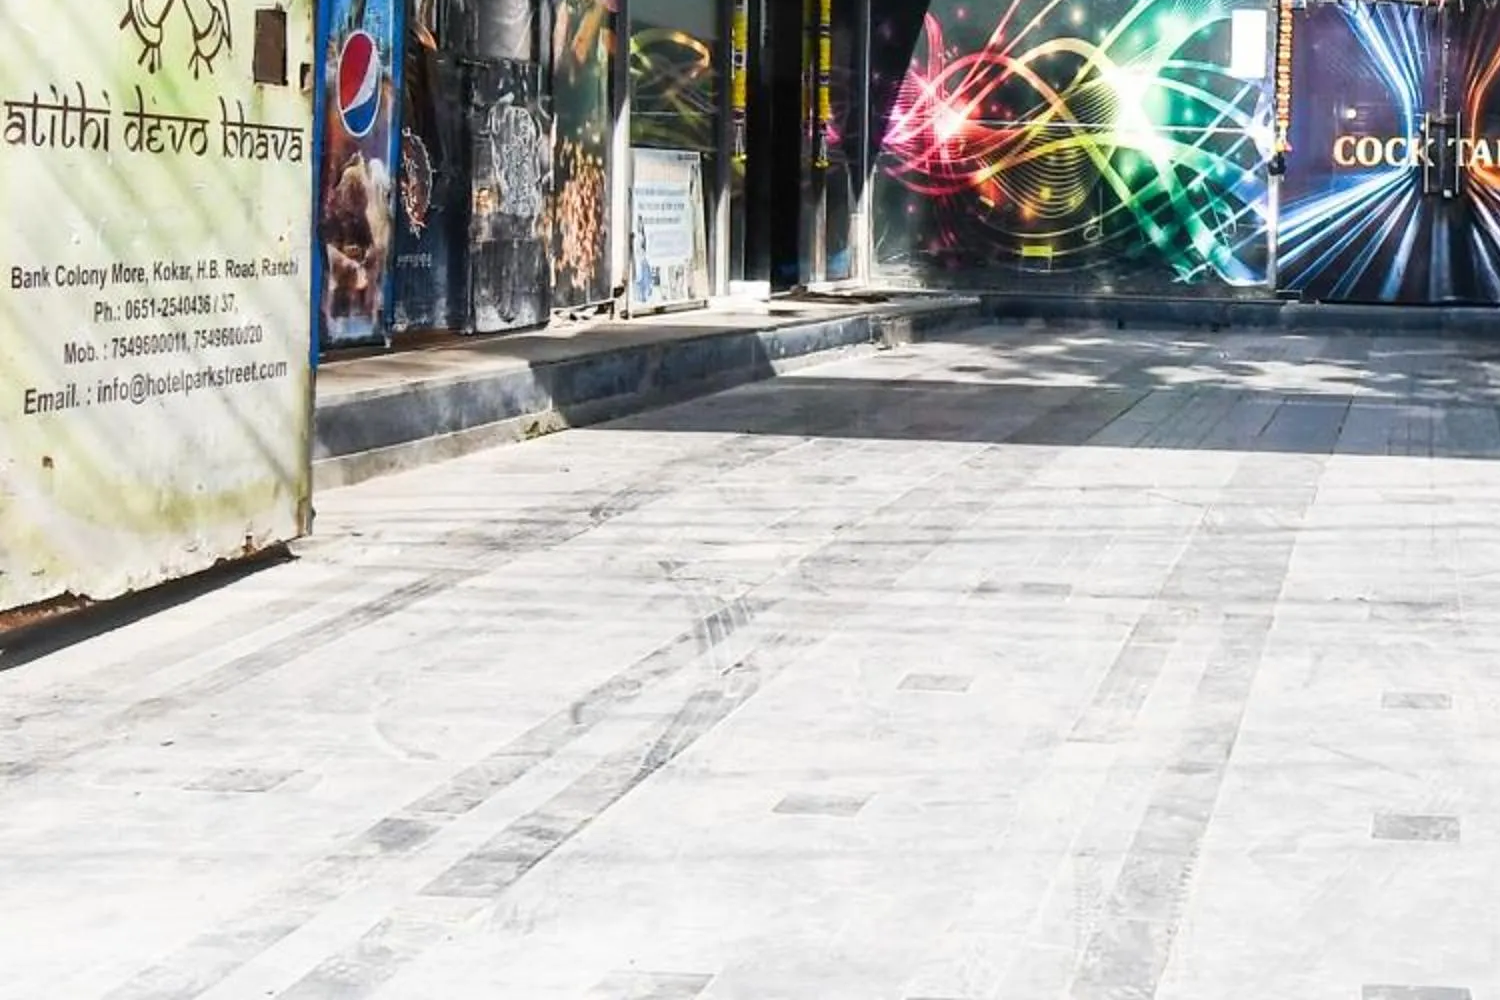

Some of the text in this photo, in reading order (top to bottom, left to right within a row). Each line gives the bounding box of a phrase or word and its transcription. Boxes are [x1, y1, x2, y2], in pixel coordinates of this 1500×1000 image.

[3, 81, 305, 163] atithi devo bhava
[11, 256, 299, 290] Bank Colony More, Kokar, H.B. Road, Ranchi
[97, 360, 288, 405] info@hotelparkstreet.com
